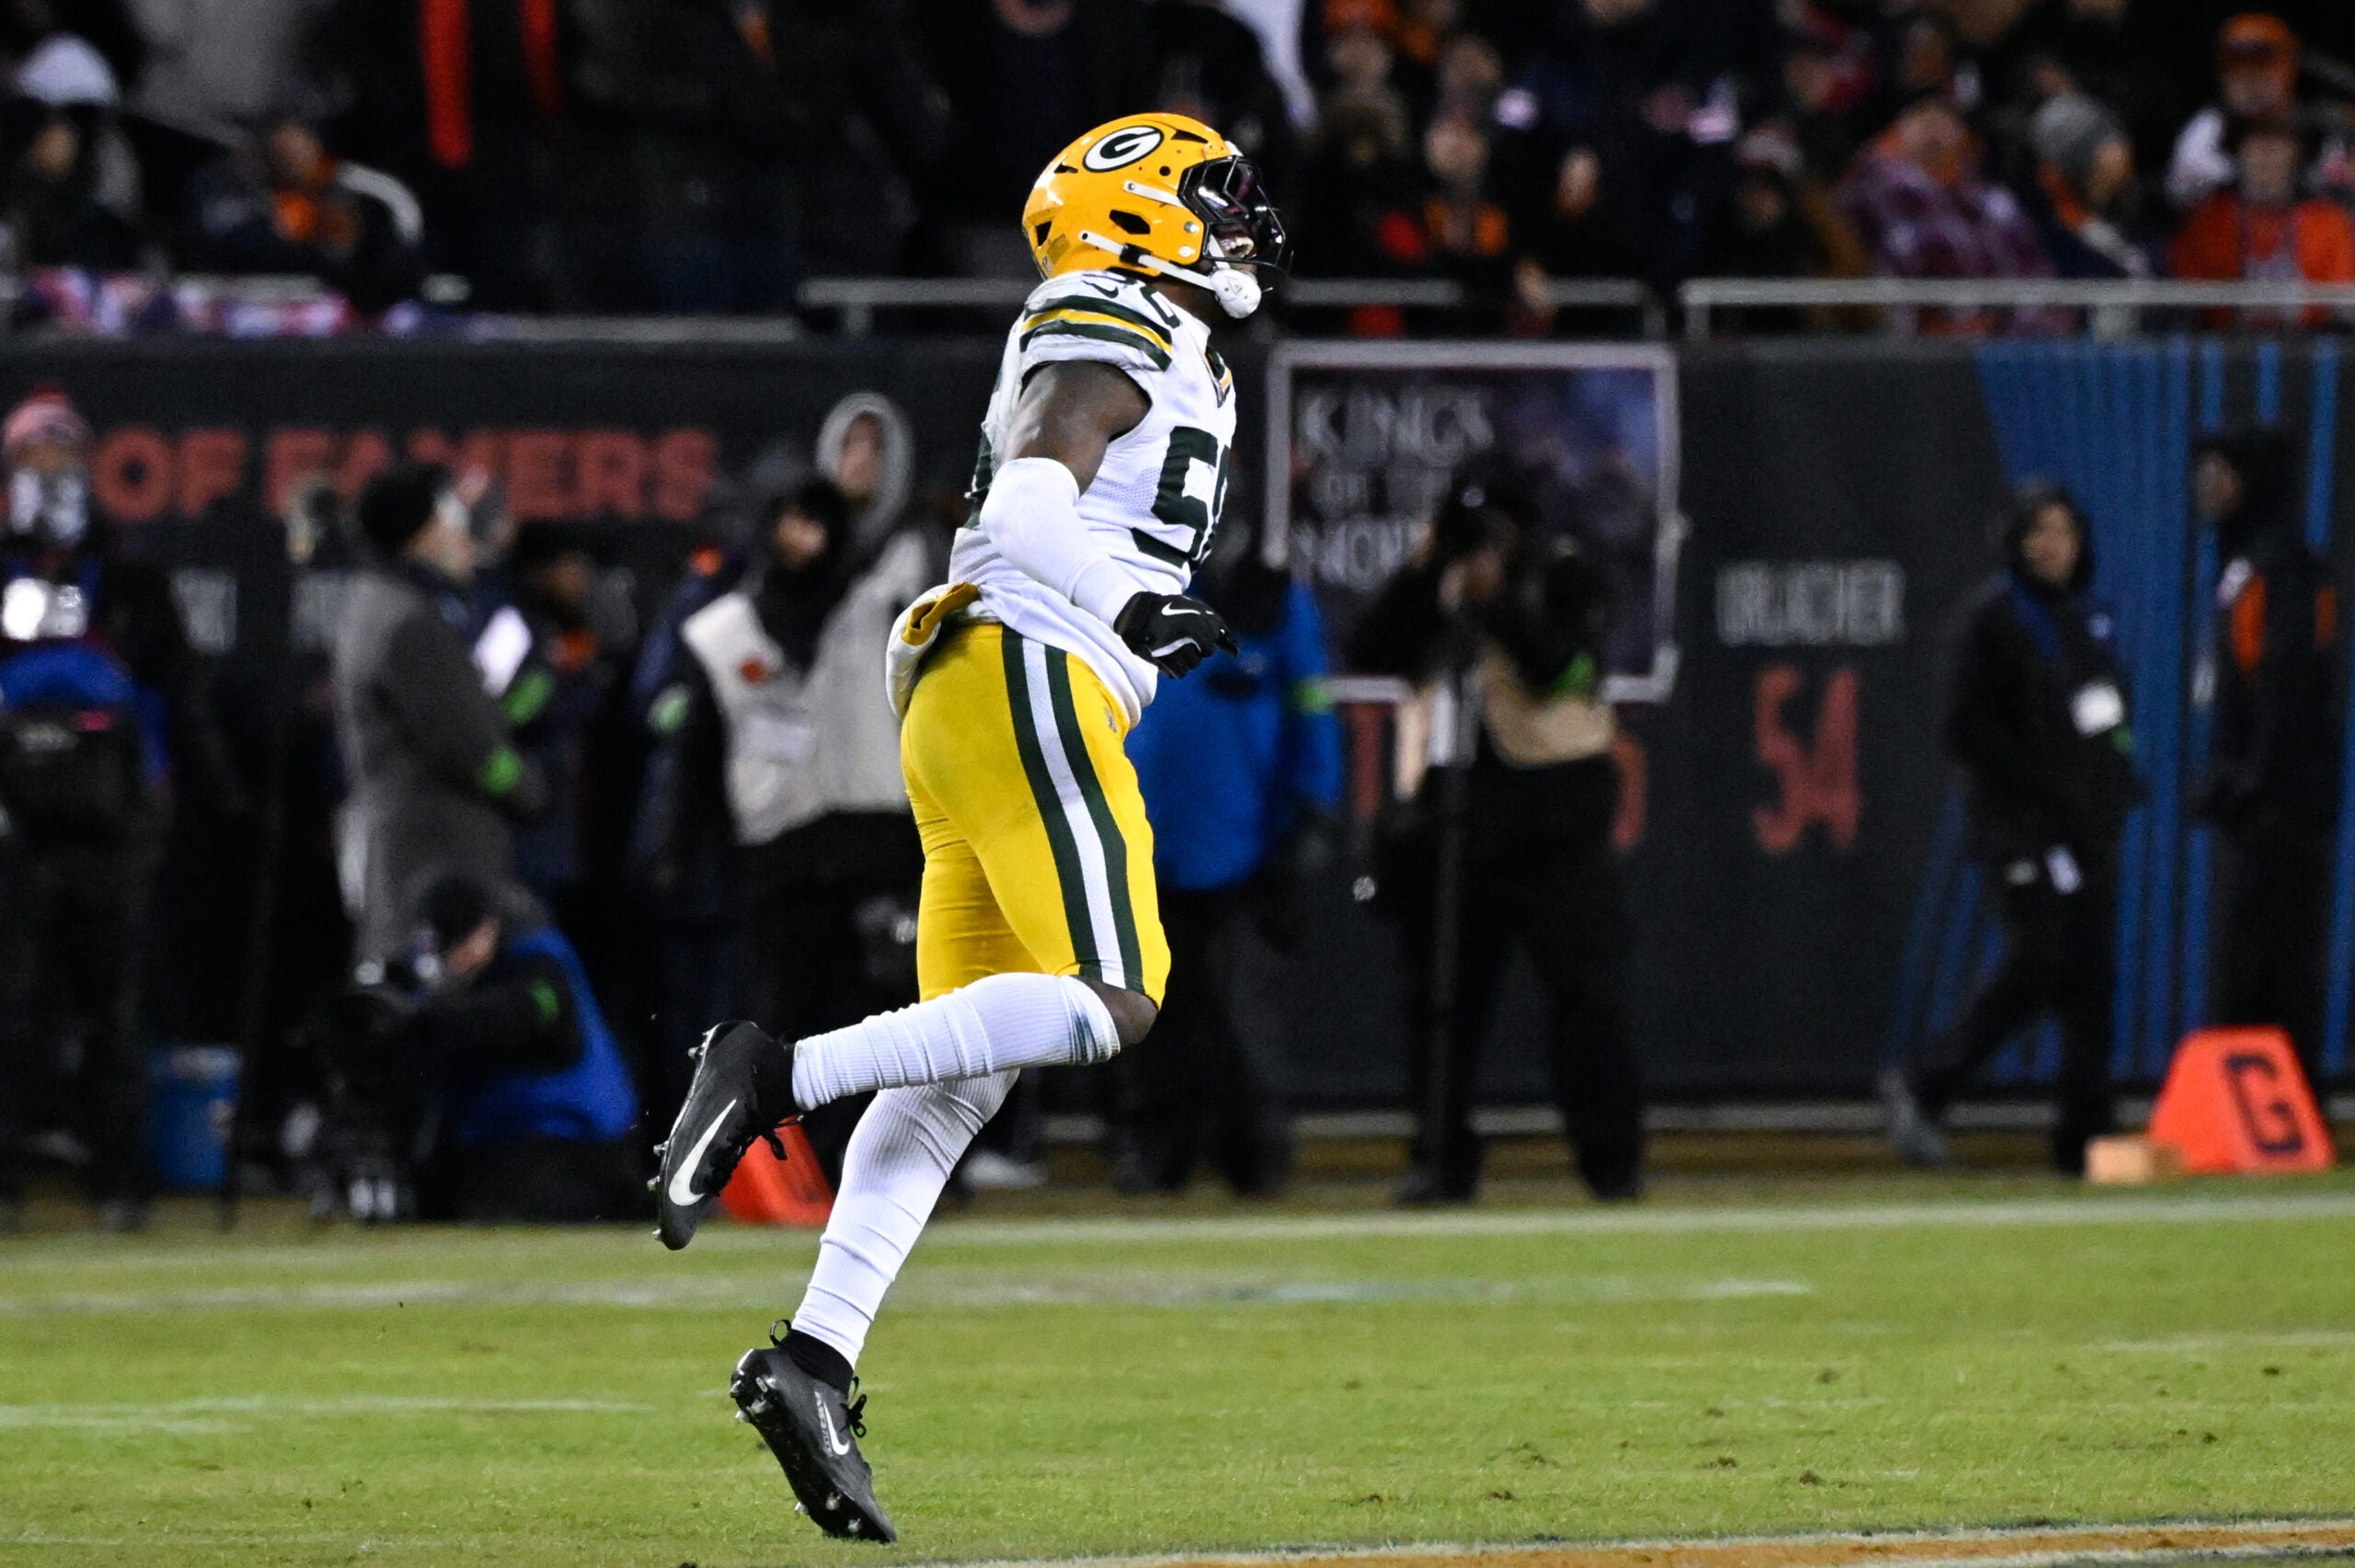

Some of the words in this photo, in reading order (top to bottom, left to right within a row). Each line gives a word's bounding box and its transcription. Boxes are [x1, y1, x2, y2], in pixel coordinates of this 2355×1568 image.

[1083, 125, 1164, 172] G
[93, 427, 248, 522] OF
[1131, 425, 1232, 572] 5
[1753, 665, 1860, 852] 54
[2223, 1051, 2304, 1155] G
